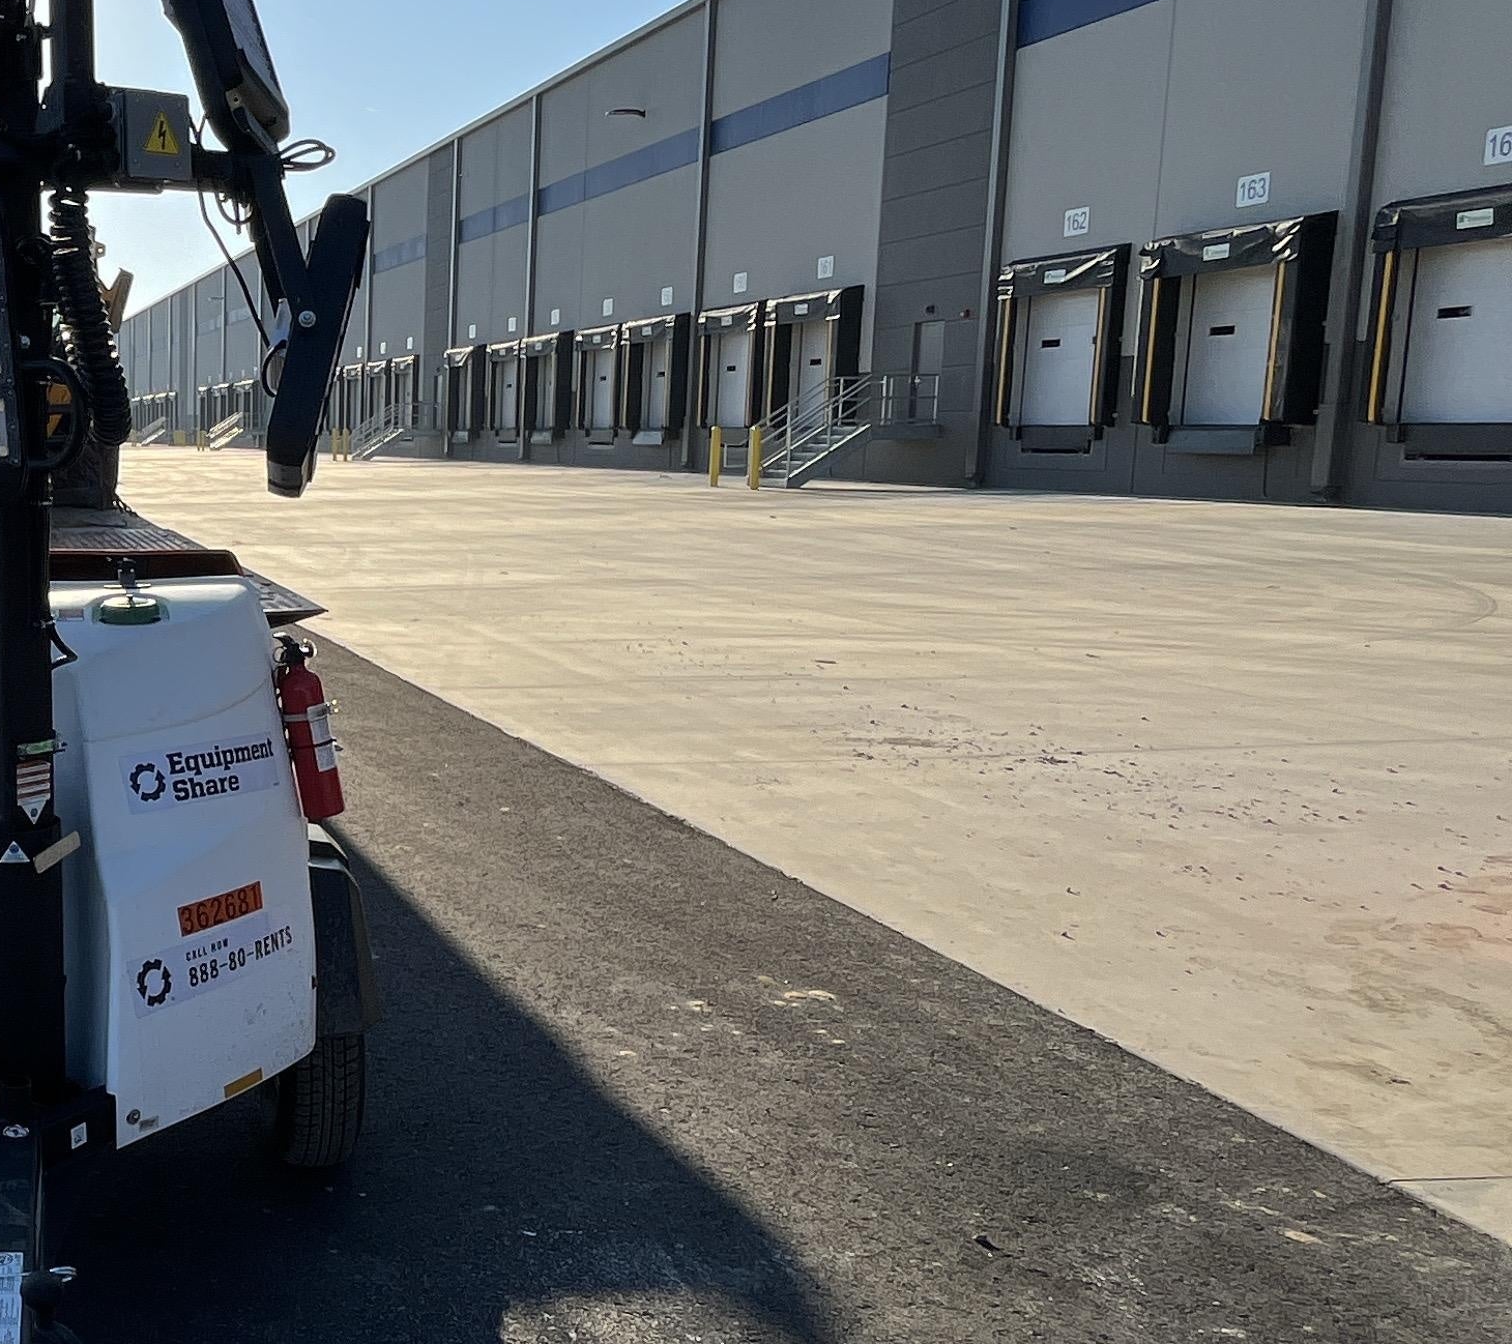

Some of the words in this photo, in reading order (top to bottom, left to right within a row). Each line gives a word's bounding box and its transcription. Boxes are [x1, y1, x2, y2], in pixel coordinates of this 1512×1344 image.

[1489, 131, 1512, 158] 16
[1240, 177, 1266, 202] 163
[1067, 211, 1087, 232] 162
[165, 737, 274, 776] Equipment
[172, 773, 240, 802] Share
[180, 885, 260, 934] 362681
[188, 925, 293, 987] 888-80-RENTS
